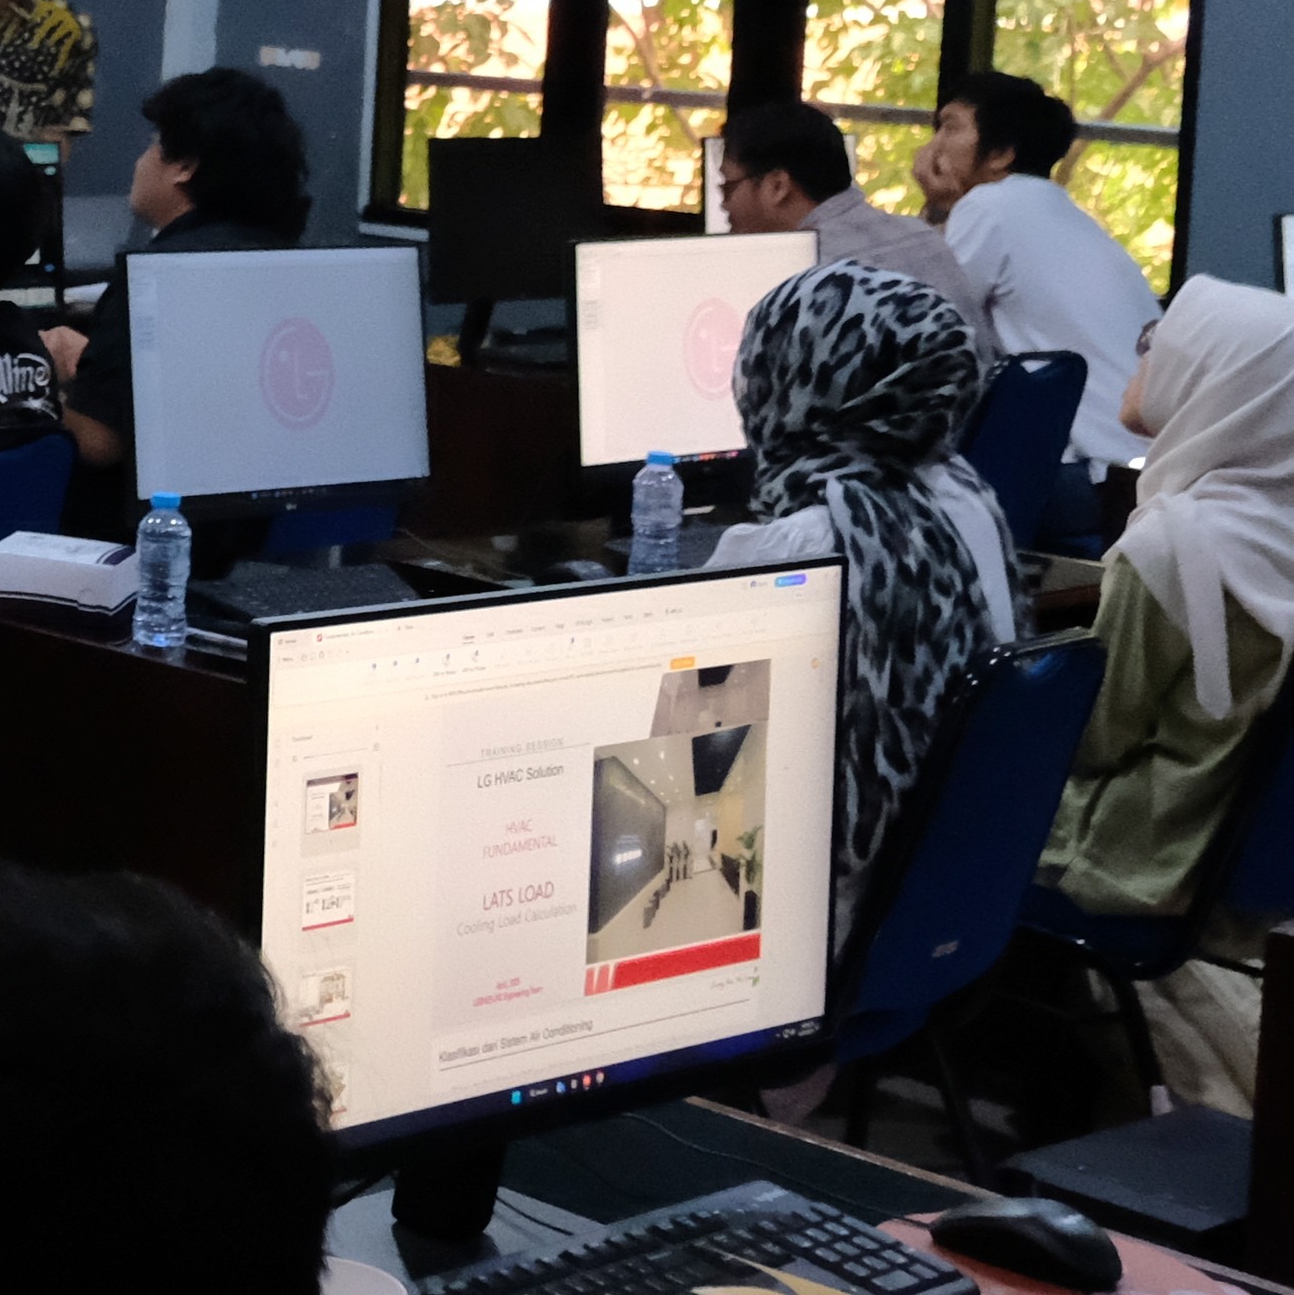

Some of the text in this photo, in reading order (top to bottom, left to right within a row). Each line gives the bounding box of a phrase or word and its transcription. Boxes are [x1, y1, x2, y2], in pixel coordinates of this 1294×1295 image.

[477, 765, 563, 788] LG HVAC Solution
[506, 818, 532, 834] HVAC
[482, 834, 557, 859] FUNDAMENTAL
[483, 881, 554, 911] LATS LOAD
[457, 904, 577, 936] Cooling Load Calculation
[543, 1019, 594, 1040] Conditioning
